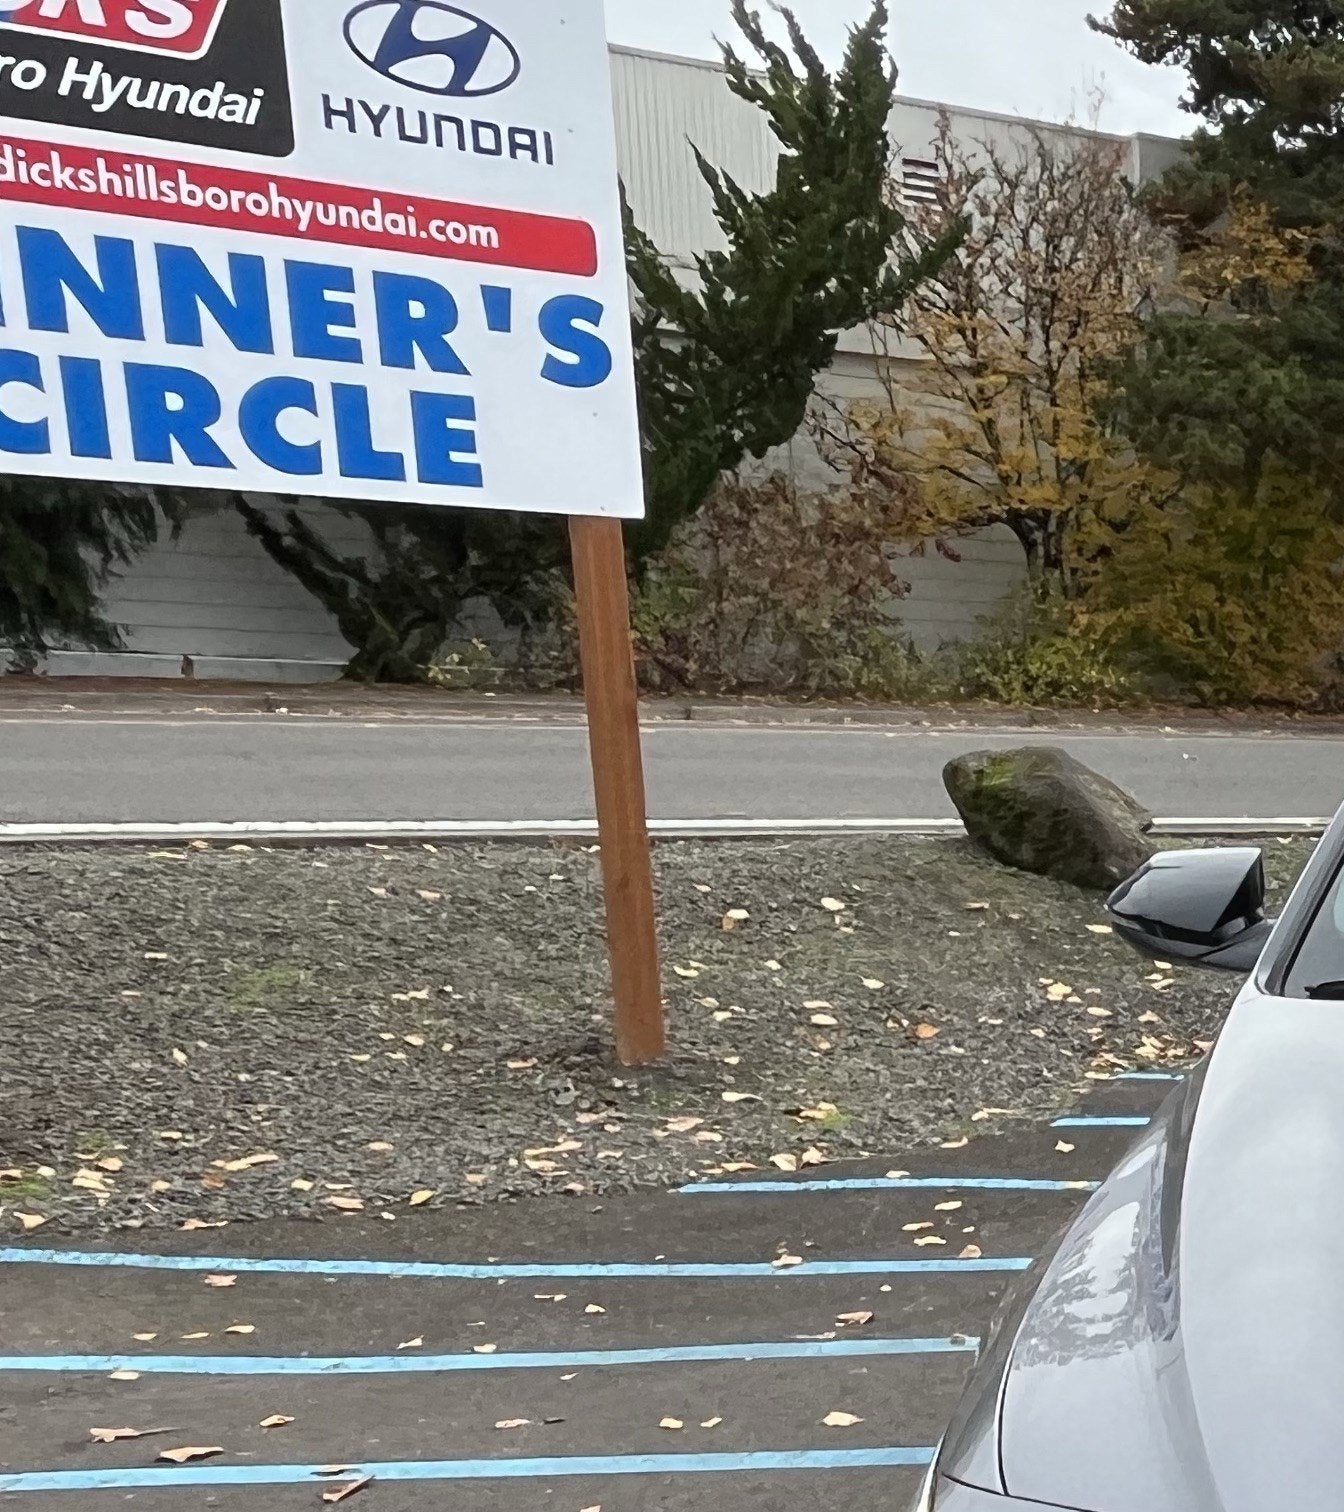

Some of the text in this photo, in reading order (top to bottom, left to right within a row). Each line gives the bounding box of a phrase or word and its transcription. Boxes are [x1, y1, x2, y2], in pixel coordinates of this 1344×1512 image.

[57, 56, 265, 125] Hyundai
[321, 93, 555, 166] HYUNDAI
[0, 143, 499, 249] dickshillsborohyundai.com
[0, 225, 612, 388] NNER'S
[0, 348, 484, 488] CIRCLE
